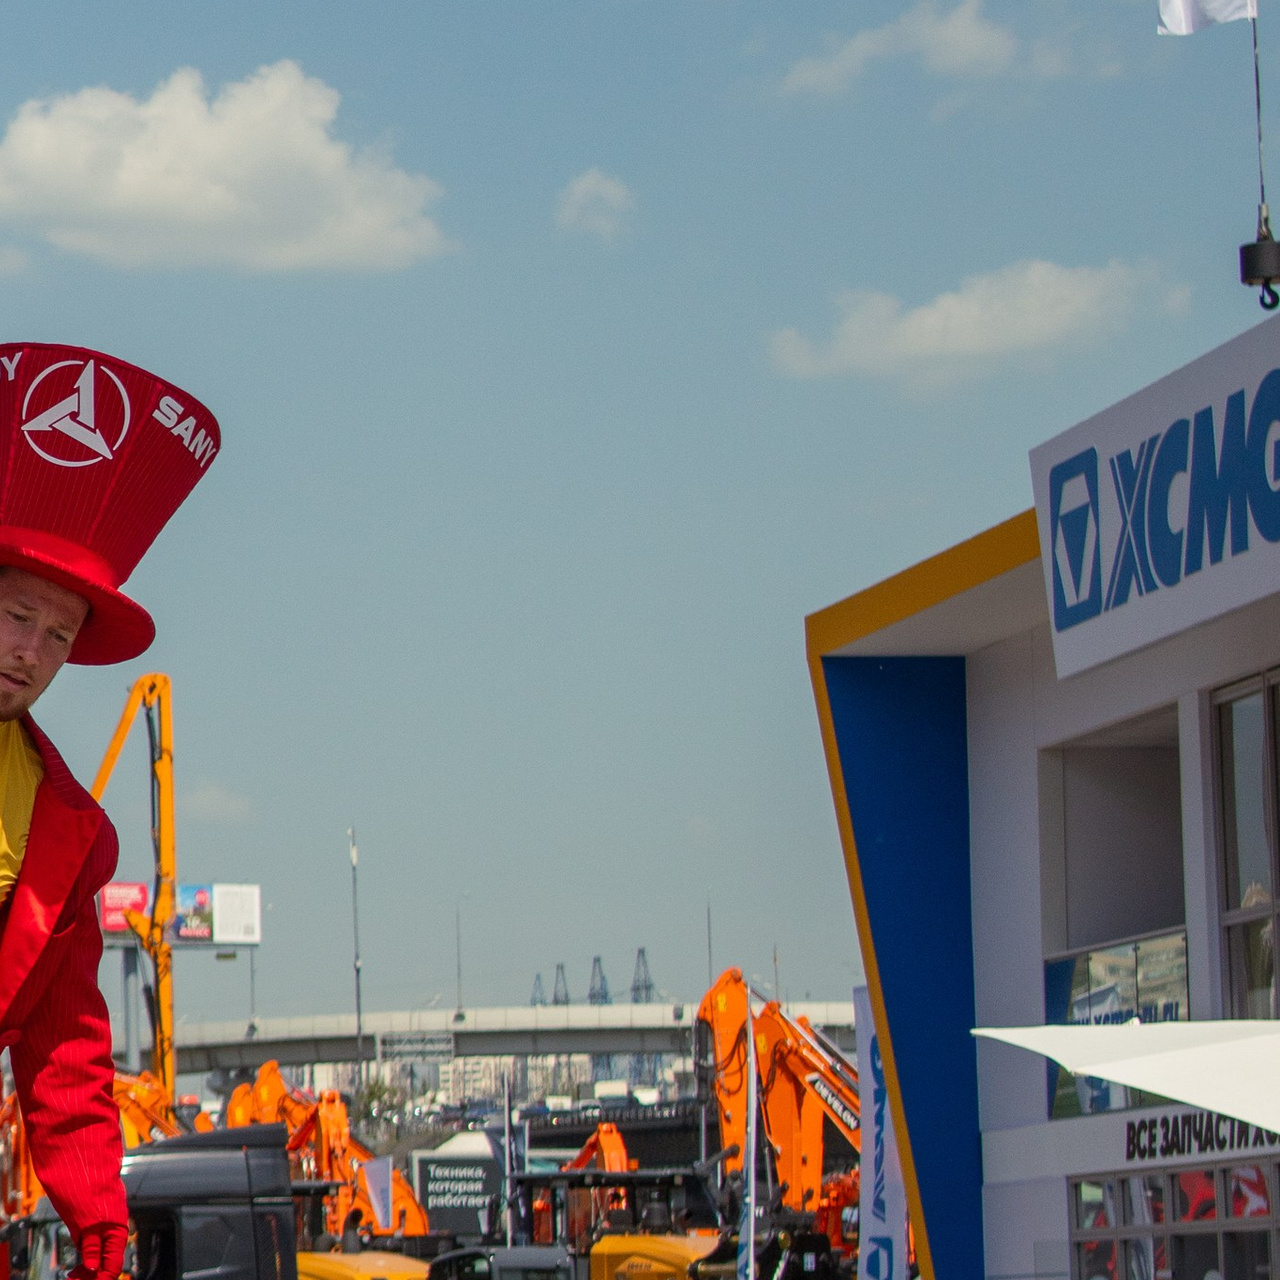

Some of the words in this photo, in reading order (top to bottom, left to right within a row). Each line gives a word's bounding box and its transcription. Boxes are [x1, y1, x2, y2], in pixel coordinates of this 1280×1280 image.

[151, 395, 218, 468] SANY
[1104, 367, 1280, 612] XCMG
[814, 1079, 859, 1130] DEVELON
[1126, 1117, 1158, 1160] ВСЕ
[1159, 1111, 1250, 1157] ЗАПЧАСТИ
[427, 1164, 487, 1180] Техника,
[427, 1180, 484, 1195] которая
